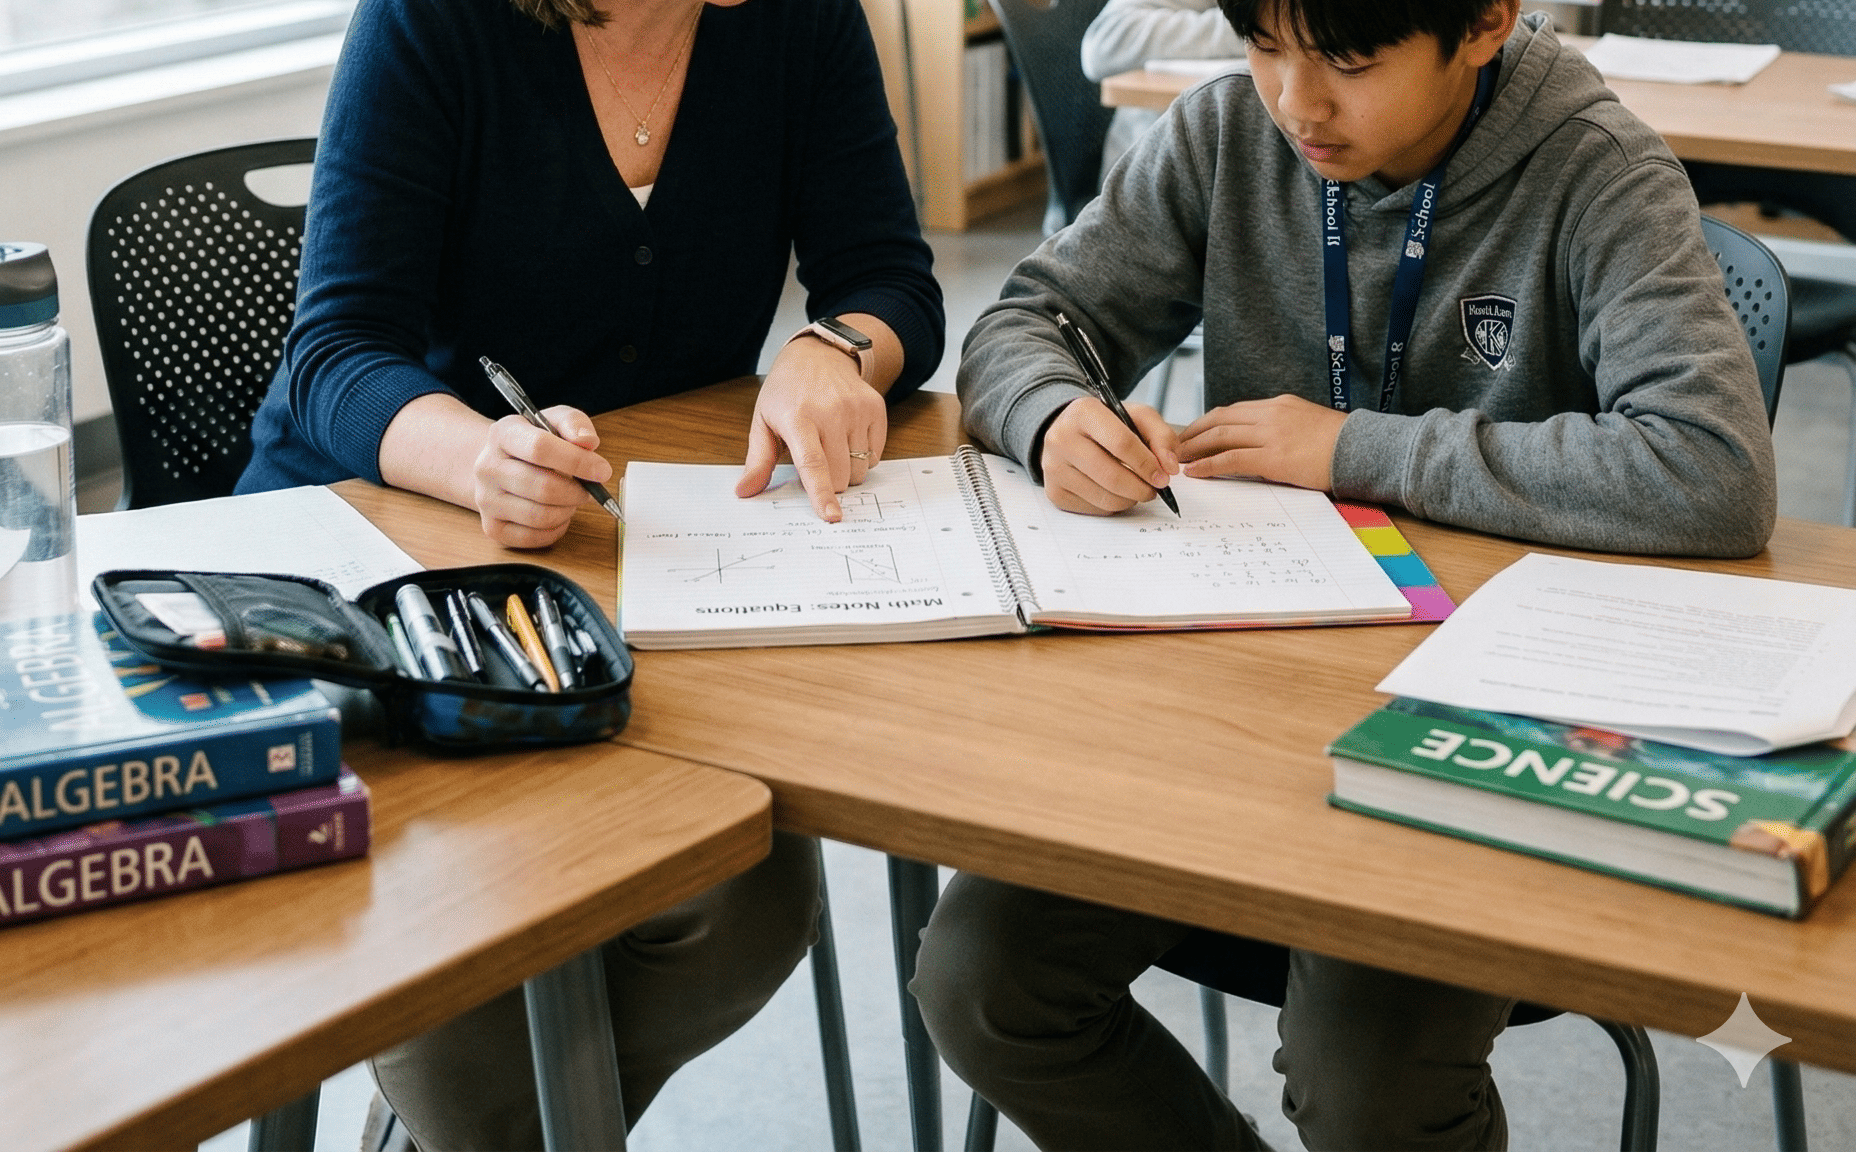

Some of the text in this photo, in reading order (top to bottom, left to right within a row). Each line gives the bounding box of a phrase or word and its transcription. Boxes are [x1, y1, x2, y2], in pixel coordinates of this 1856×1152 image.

[1411, 182, 1436, 241] School
[1331, 352, 1346, 399] School
[695, 598, 943, 615] Math Notes: Equations
[0, 750, 219, 825] ALGEBRA
[1411, 728, 1742, 822] SCIENCE
